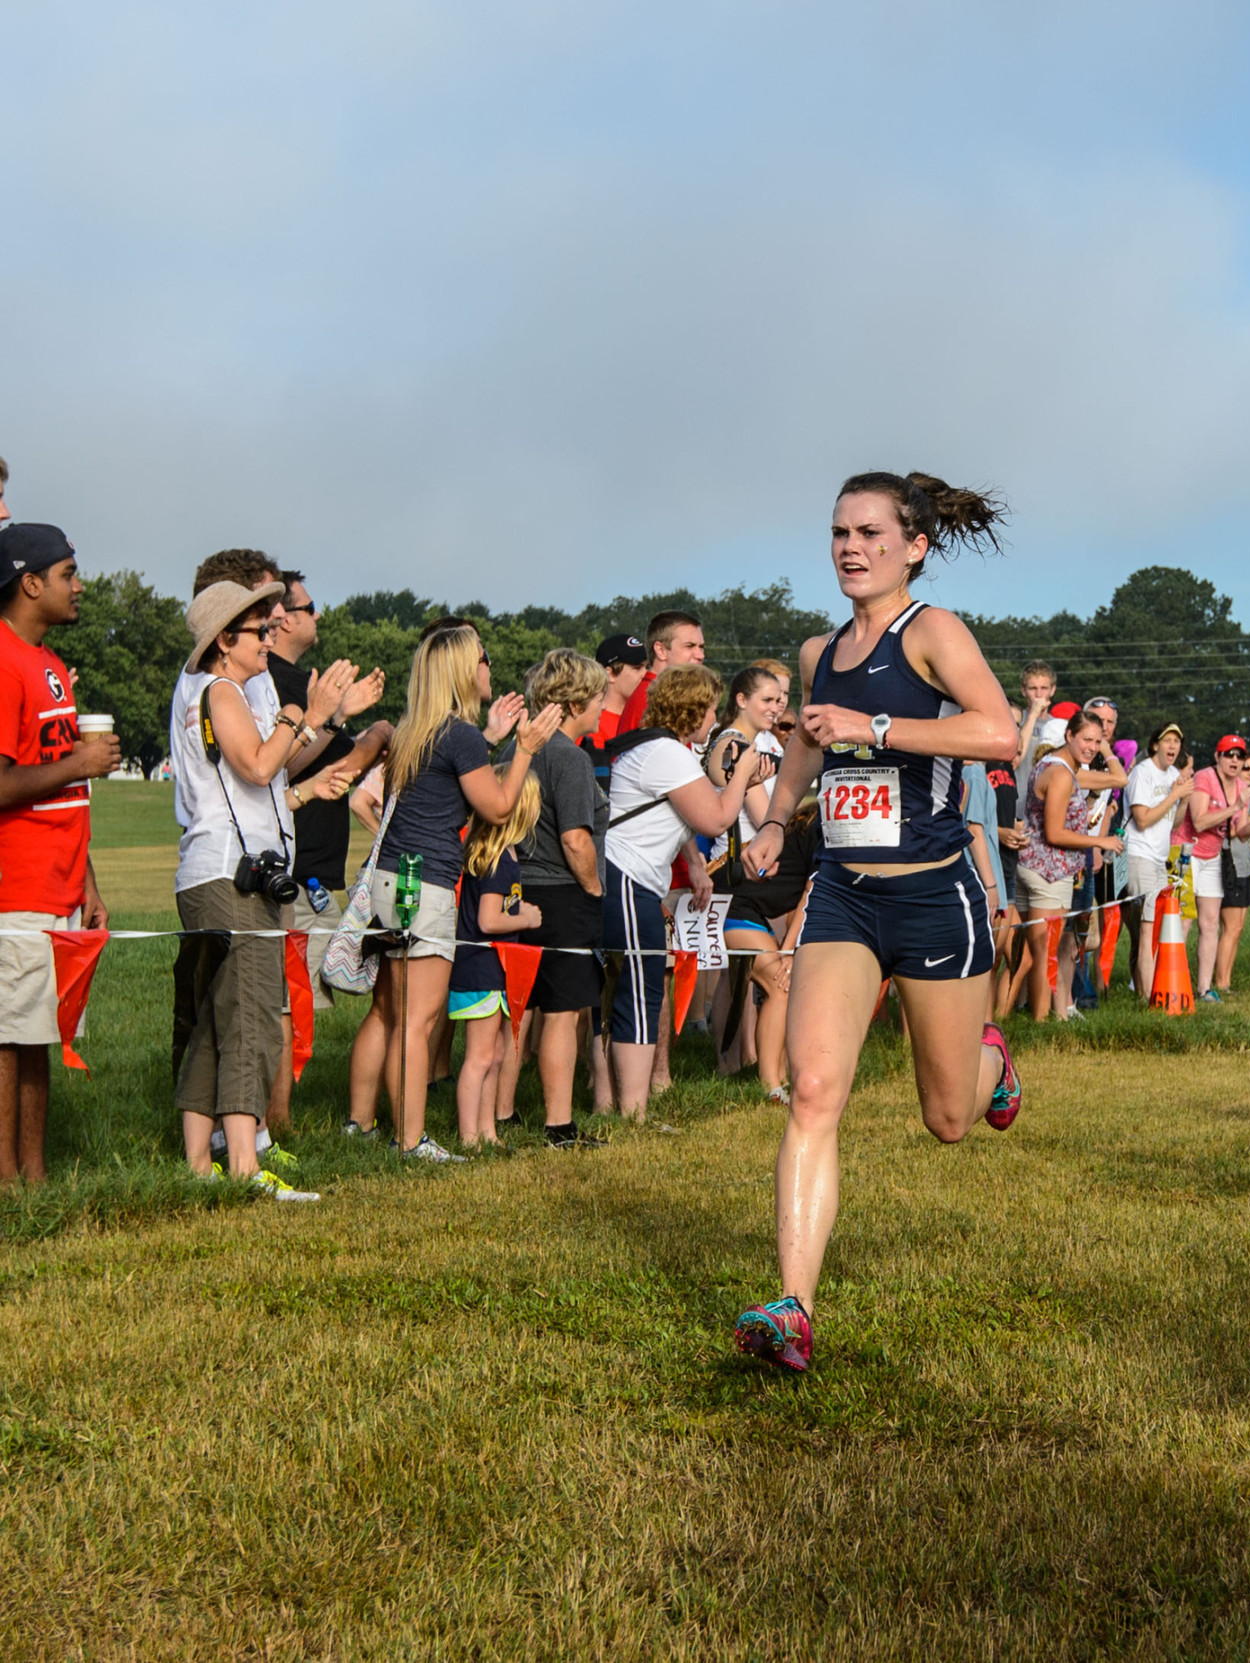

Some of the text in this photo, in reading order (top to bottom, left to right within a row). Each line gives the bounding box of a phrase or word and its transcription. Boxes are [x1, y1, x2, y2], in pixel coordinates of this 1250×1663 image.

[823, 784, 893, 822] 1234
[706, 900, 729, 967] Lauren
[1153, 991, 1190, 1011] GPD
